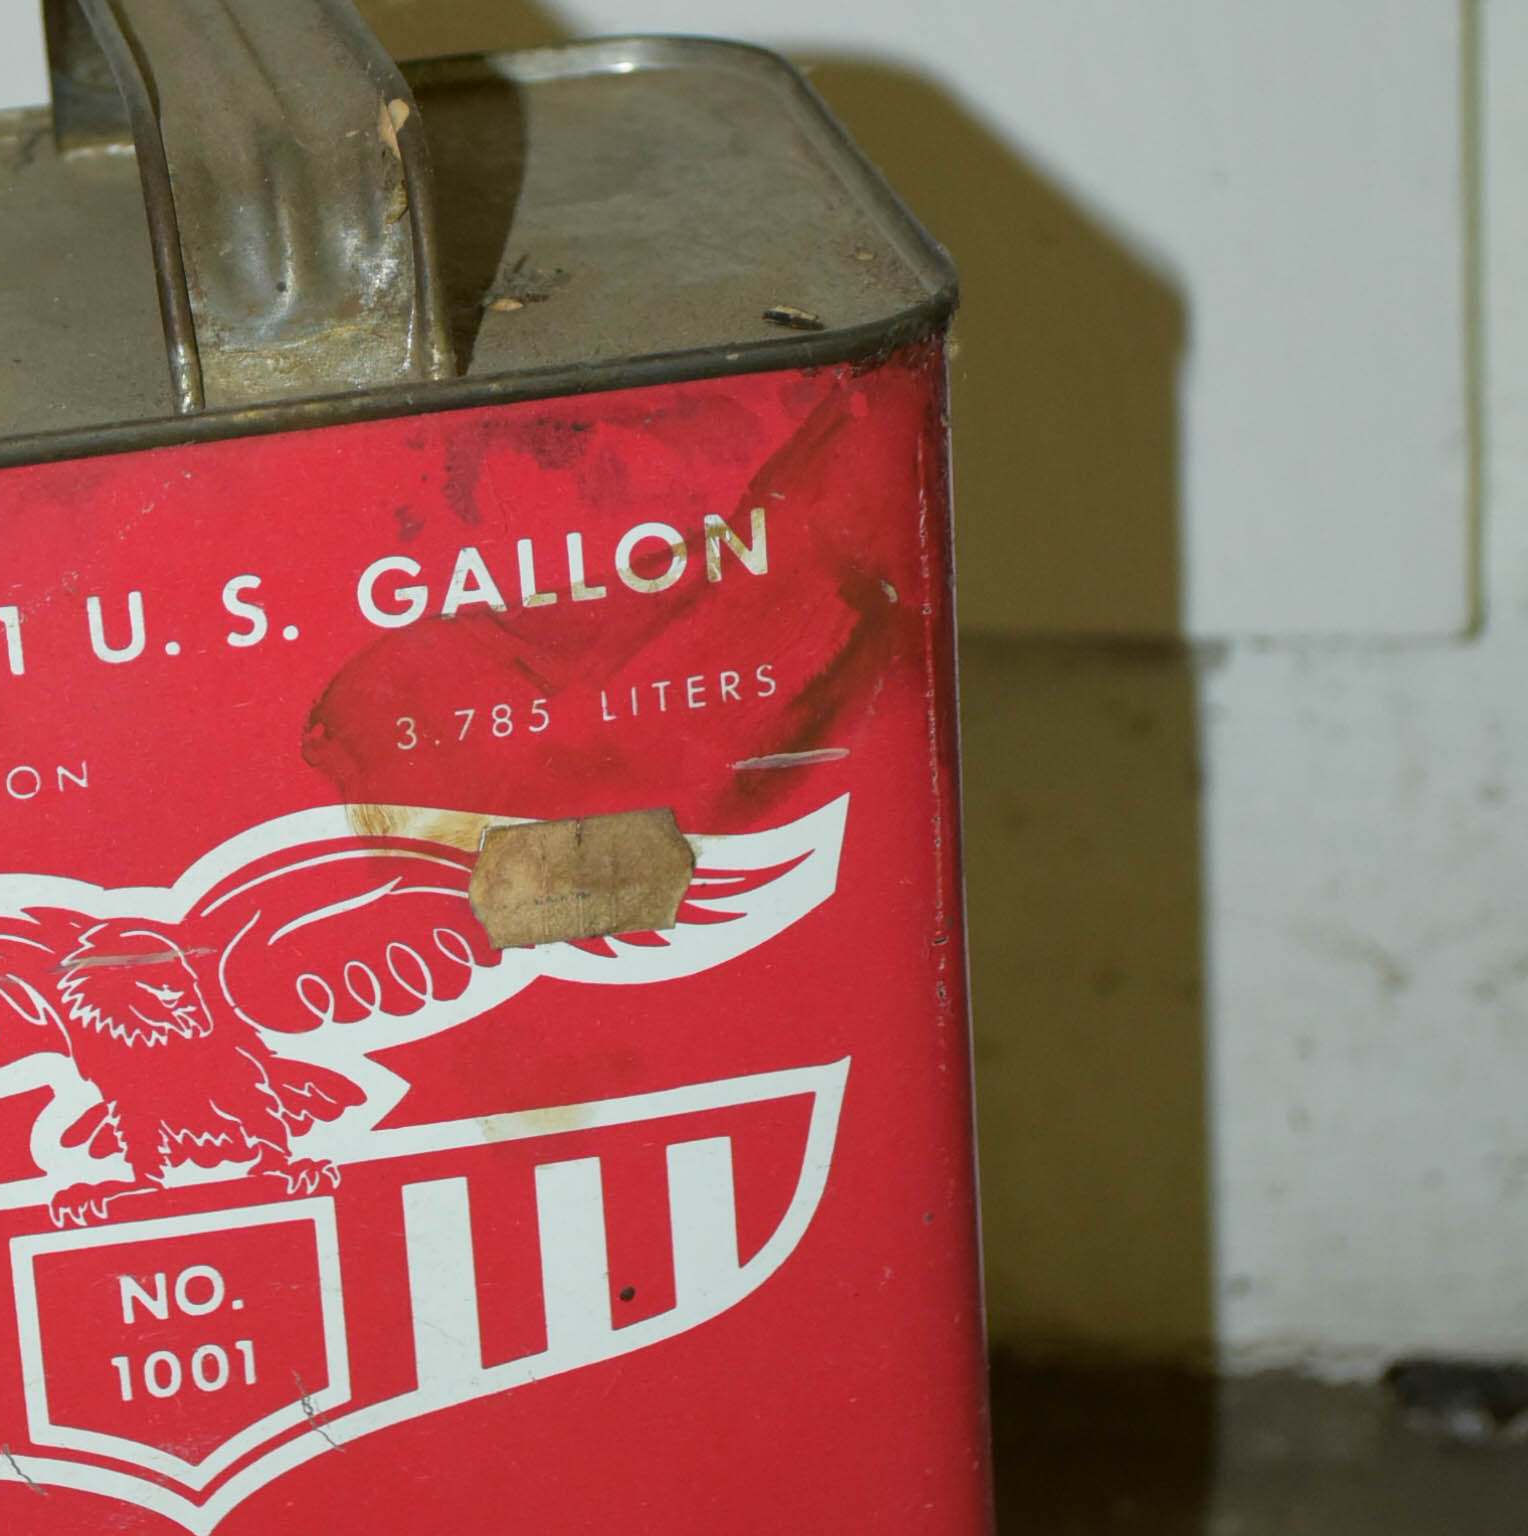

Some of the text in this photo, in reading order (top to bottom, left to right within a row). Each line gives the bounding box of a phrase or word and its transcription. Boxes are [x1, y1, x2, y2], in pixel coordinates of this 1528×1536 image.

[357, 507, 768, 629] GALLON
[395, 665, 779, 751] 3.785 LITERS
[117, 1265, 245, 1324] NO.
[111, 1339, 257, 1402] 1001
